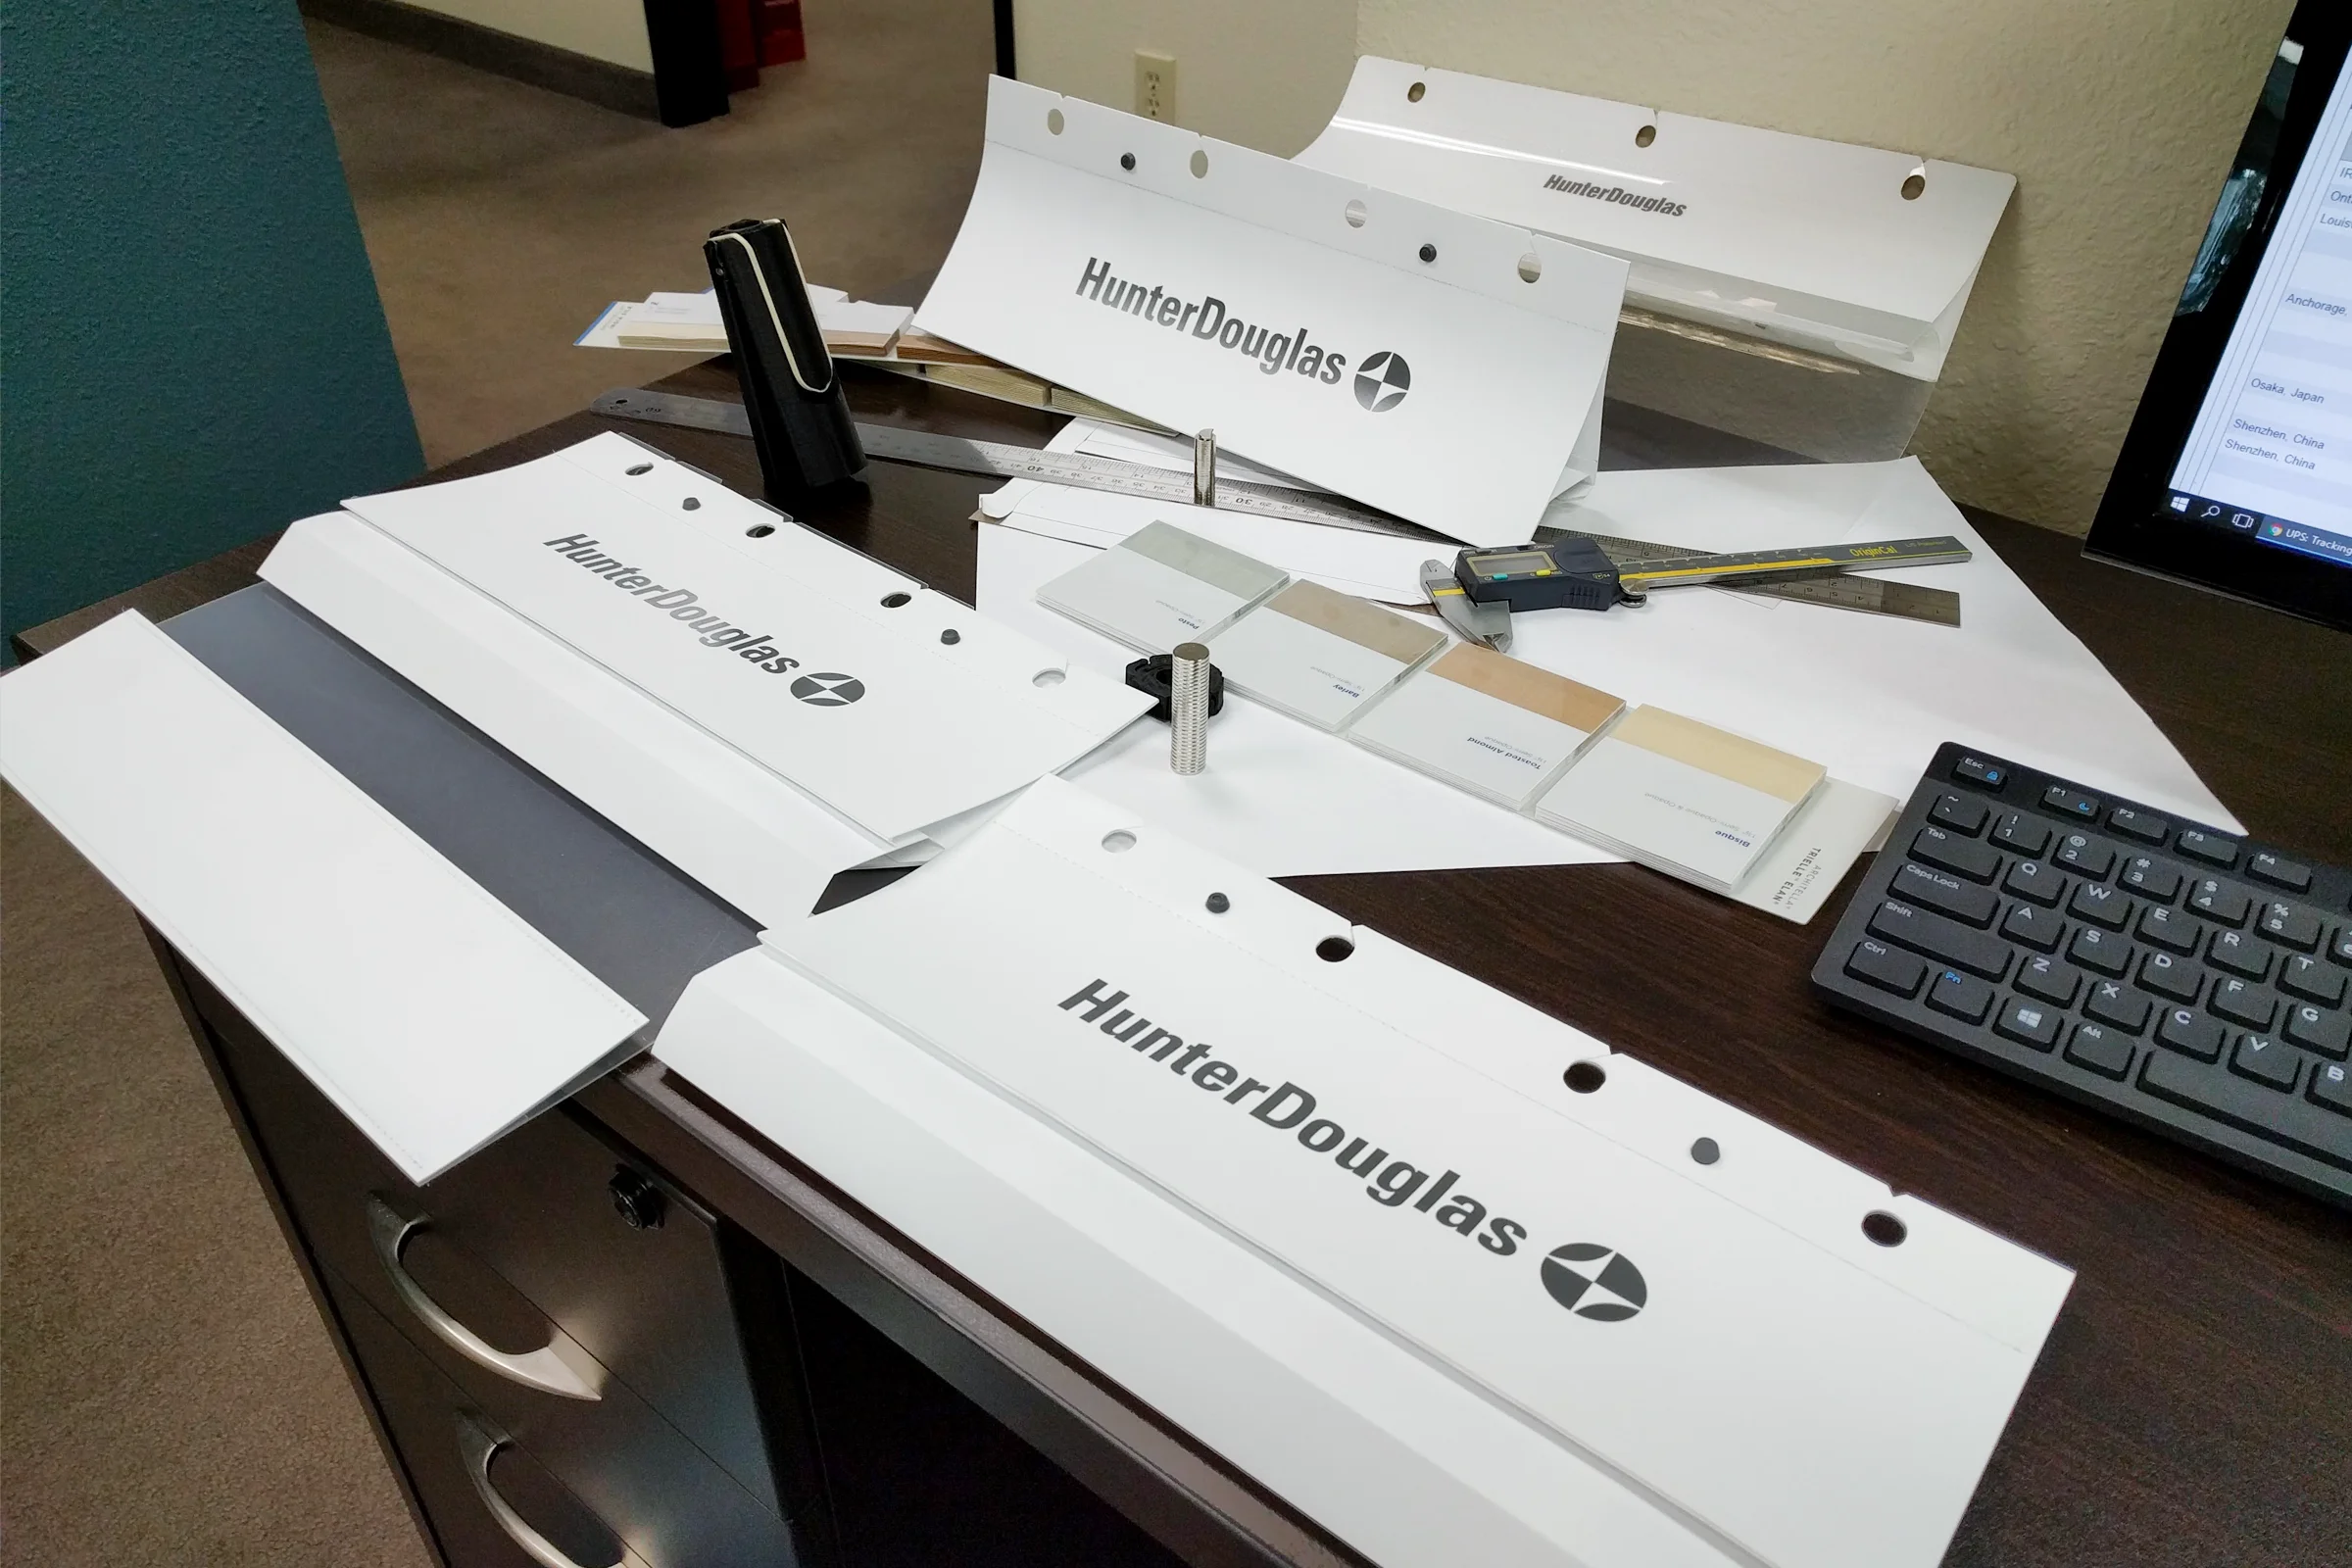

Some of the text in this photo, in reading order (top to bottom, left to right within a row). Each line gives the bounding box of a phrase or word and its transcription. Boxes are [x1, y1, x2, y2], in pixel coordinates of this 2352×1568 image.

[1544, 174, 1688, 217] HunterDouglas
[2331, 191, 2352, 205] Ont
[2321, 214, 2352, 228] Louis
[2285, 294, 2348, 317] Anchorage,
[1076, 257, 1347, 385] HunterDouglas
[2251, 377, 2325, 404] Osaka, Japan
[2233, 418, 2326, 450] Shenzhen, China
[2225, 438, 2316, 469] Shenzhen, China
[1849, 545, 1898, 558] OriginCal
[543, 533, 801, 674] HunterDouglas
[1178, 617, 1200, 630] Pesto
[1333, 684, 1360, 699] Barley
[1466, 737, 1504, 755] Almond
[1504, 752, 1542, 770] Toasted
[1965, 758, 1984, 769] Esc
[2051, 787, 2066, 797] F1
[2119, 808, 2134, 819] F2
[1715, 830, 1750, 848] Bisque
[1928, 827, 1946, 840] Tab
[2005, 828, 2013, 837] 1
[2070, 835, 2086, 848] @
[2065, 850, 2079, 860] 2
[2022, 862, 2037, 876] Q
[1906, 864, 1960, 890] Caps Lock
[2132, 871, 2144, 882] 3
[2087, 884, 2111, 901] W
[2198, 897, 2212, 906] 4
[1886, 902, 1913, 917] Shift
[2018, 906, 2033, 920] A
[2154, 907, 2170, 921] E
[2274, 903, 2289, 917] %
[2270, 918, 2283, 930] 5
[2085, 930, 2102, 943] S
[2224, 931, 2241, 947] R
[1864, 941, 1887, 956] Ctrl
[2033, 957, 2051, 972] Z
[2155, 954, 2173, 968] D
[2298, 956, 2314, 970] T
[1945, 971, 1962, 984] Fn
[2102, 982, 2120, 999] X
[2228, 980, 2244, 992] F
[2175, 1010, 2192, 1024] C
[2301, 1007, 2319, 1021] G
[2082, 1025, 2102, 1039] Alt
[2250, 1036, 2269, 1052] V
[2328, 1065, 2345, 1081] B
[1057, 978, 1528, 1256] HunterDouglas
